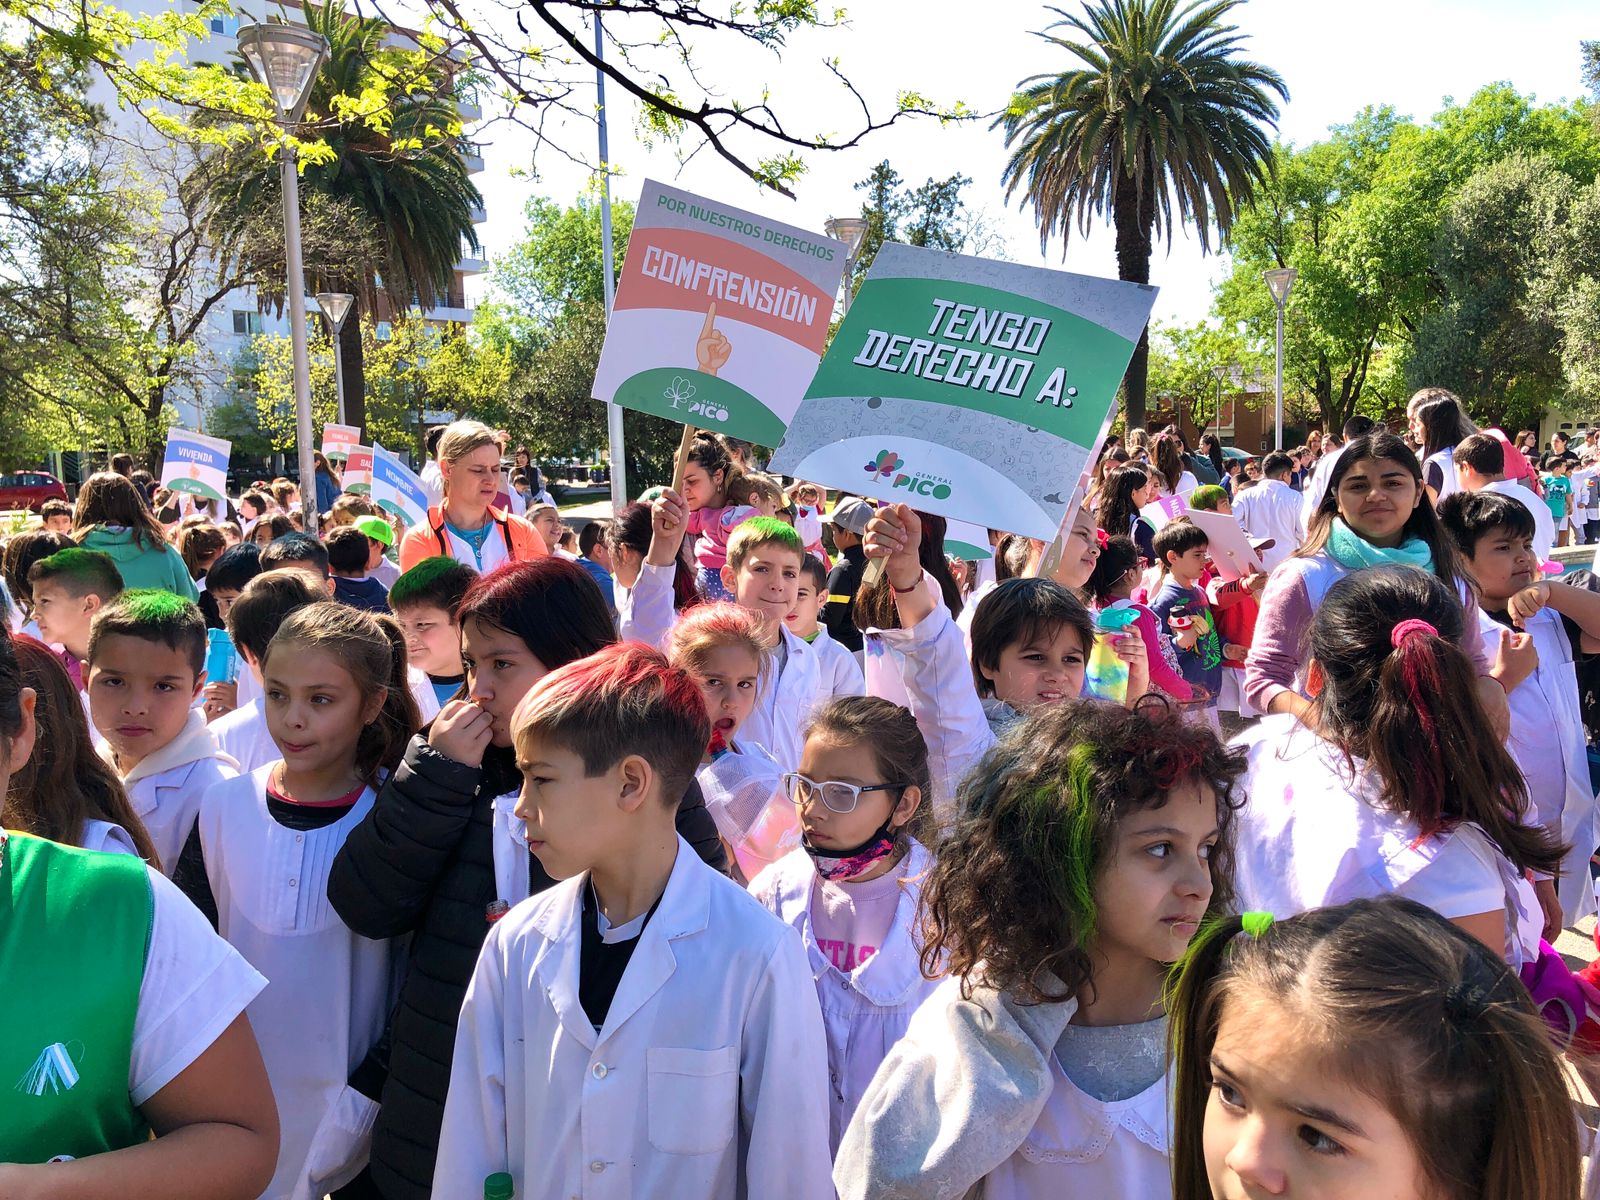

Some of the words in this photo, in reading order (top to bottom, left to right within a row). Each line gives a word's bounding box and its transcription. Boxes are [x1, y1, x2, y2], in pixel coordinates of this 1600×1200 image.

[657, 194, 687, 215] POR
[689, 205, 762, 238] NUESTROS
[764, 229, 835, 262] DERECHOS
[641, 245, 818, 326] COMPRENSIÓN
[927, 298, 1052, 355] TENGO
[852, 328, 1034, 398] DERECHO
[1034, 367, 1078, 408] A:
[688, 401, 729, 422] PICO
[702, 399, 729, 411] GENERAL
[178, 446, 213, 463] VIVIENDA
[385, 467, 414, 496] NOMBRE
[892, 473, 952, 500] PICO
[915, 471, 952, 485] GENERAL
